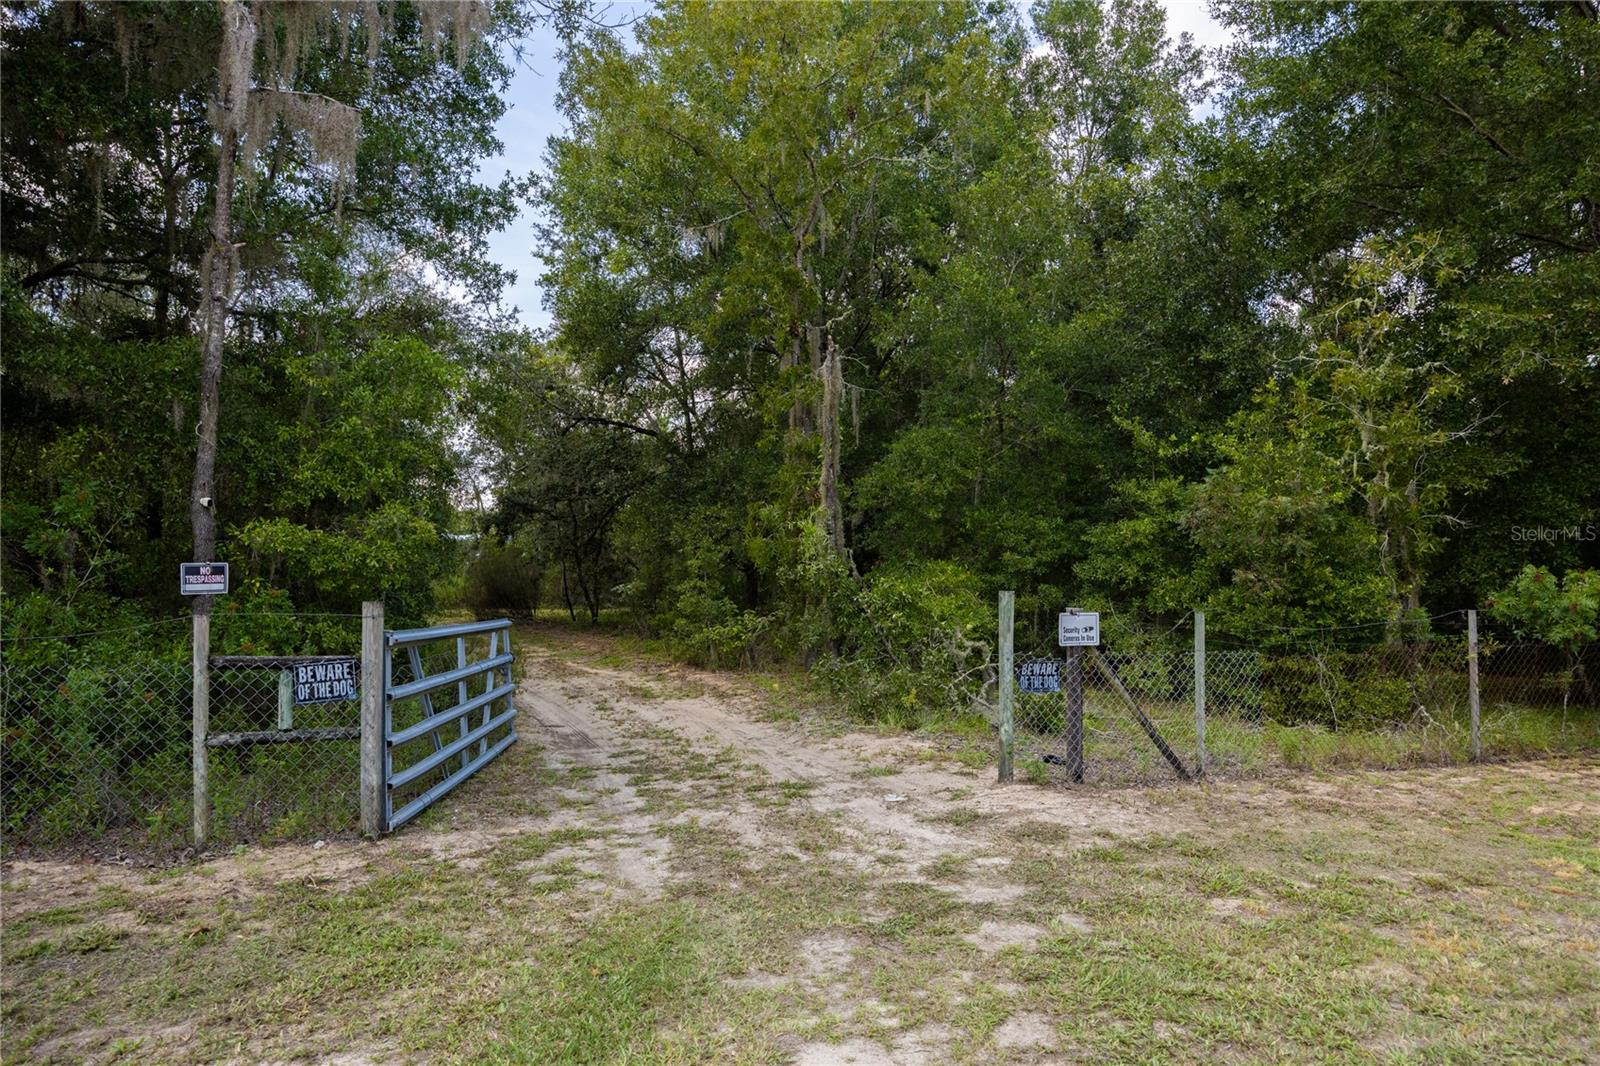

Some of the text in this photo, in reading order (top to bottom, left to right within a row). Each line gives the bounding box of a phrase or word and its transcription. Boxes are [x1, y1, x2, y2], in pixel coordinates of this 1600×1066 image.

[200, 566, 210, 575] NO
[185, 575, 224, 584] TRESPASSING
[1063, 626, 1080, 635] Security
[298, 663, 351, 683] BEWARE
[1021, 663, 1059, 675] BEWARE
[1020, 675, 1058, 688] OF THE DOG
[298, 679, 354, 700] OF THE DOG
